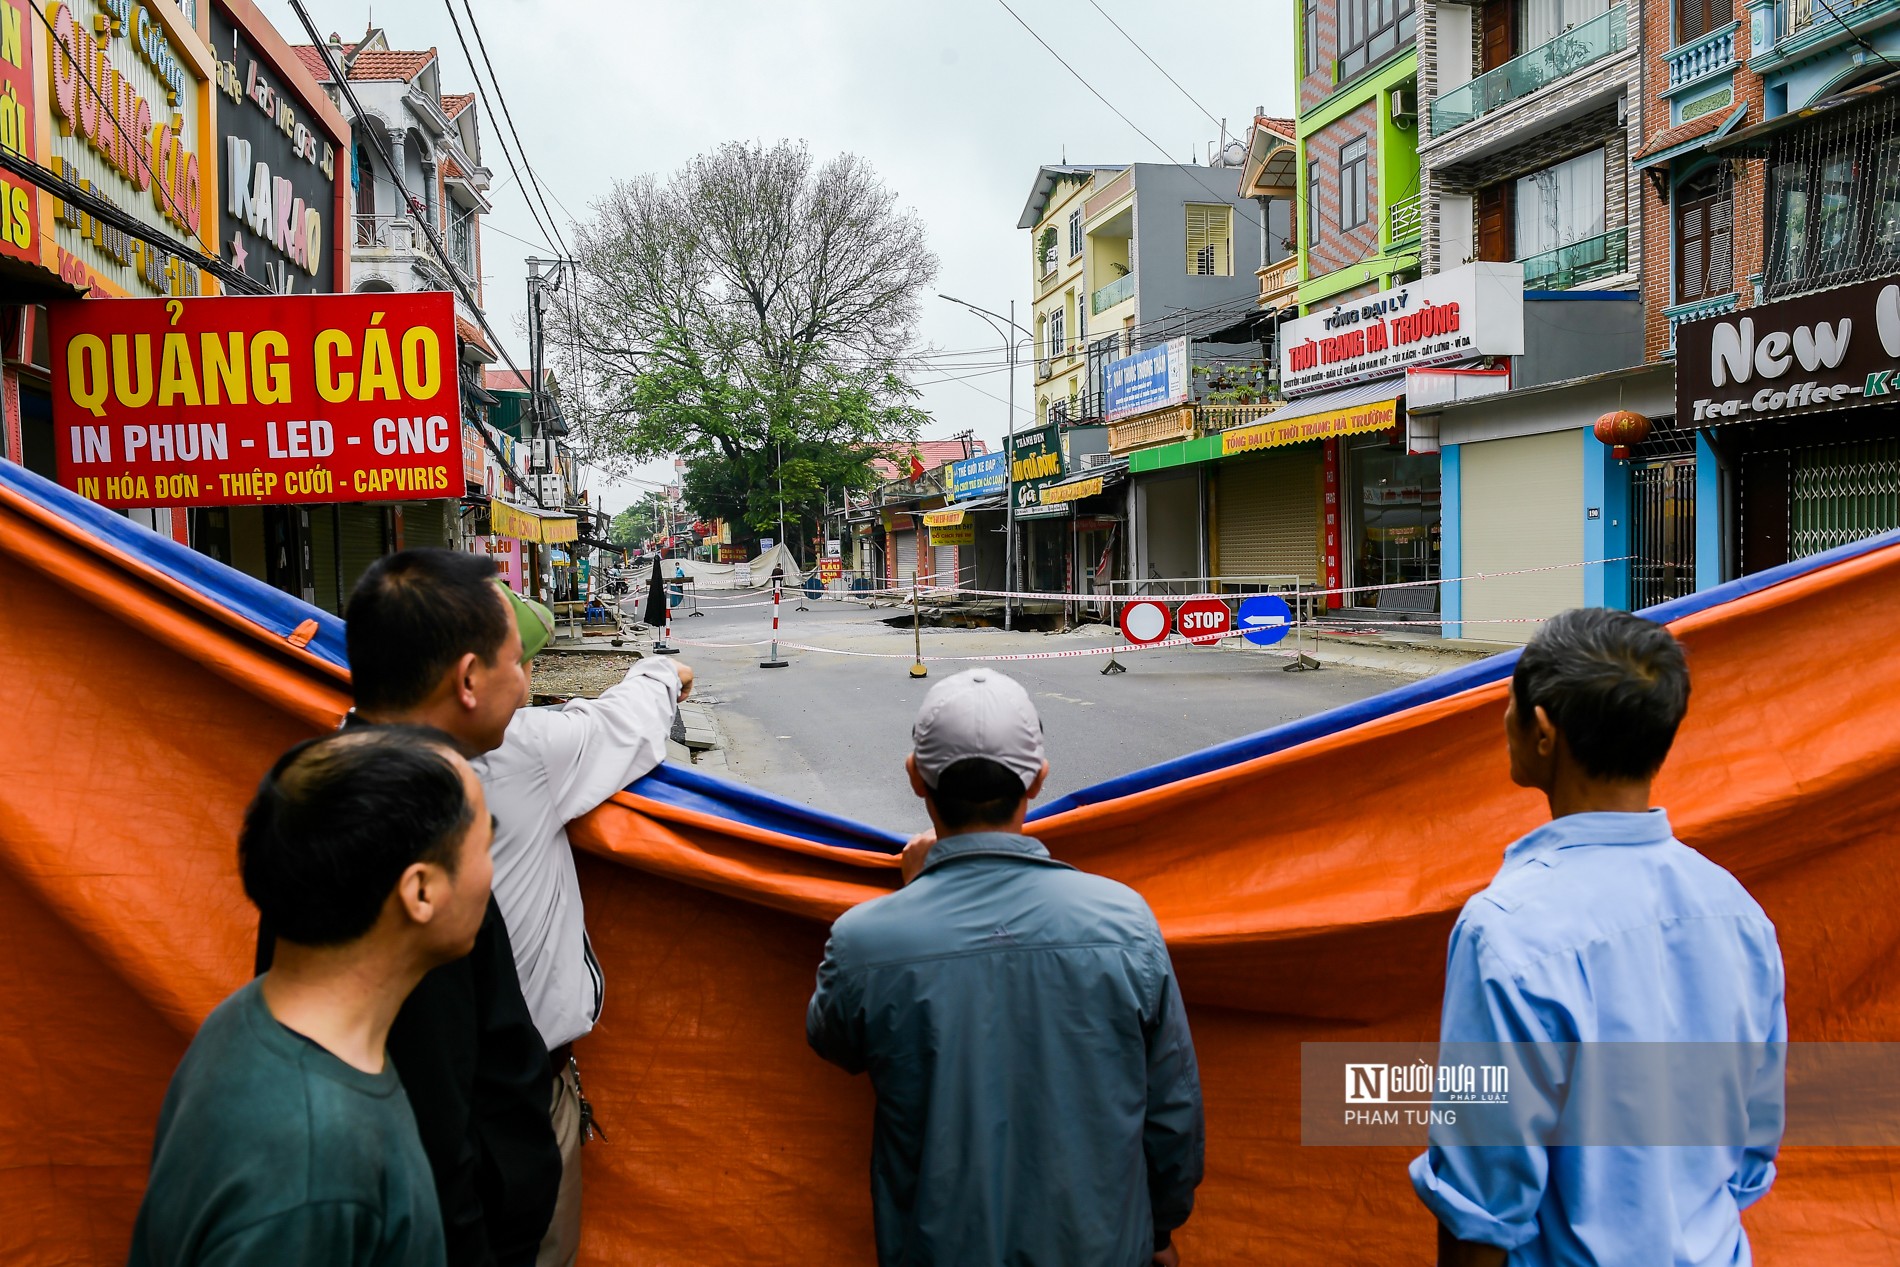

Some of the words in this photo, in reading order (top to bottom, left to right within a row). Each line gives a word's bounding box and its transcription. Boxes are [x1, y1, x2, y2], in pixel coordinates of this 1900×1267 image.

[46, 2, 152, 193] QUẢNG
[152, 112, 200, 236] CÁO
[227, 135, 321, 277] KAKAO
[1323, 306, 1360, 330] TỔNG
[1361, 300, 1388, 319] ĐẠI
[1389, 289, 1408, 311] LÝ
[67, 299, 292, 417] QUẢNG
[313, 311, 441, 404] CÁO
[1289, 337, 1318, 372] THỜI
[1319, 329, 1364, 365] TRANG
[1366, 317, 1388, 353] HÀ
[1391, 299, 1460, 347] TRƯỜNG
[1401, 349, 1417, 361] XÁCH
[1711, 316, 1852, 388] New
[70, 425, 112, 464] IN
[123, 422, 229, 463] PHUN
[266, 419, 335, 459] LED
[373, 414, 450, 456] CNC
[1248, 434, 1263, 447] ĐẠI
[1264, 428, 1276, 445] LÝ
[1278, 427, 1298, 441] THỜI
[1300, 420, 1331, 437] TRANG
[1333, 414, 1347, 431] HÀ
[1350, 408, 1393, 428] TRƯỜNG
[77, 476, 100, 500] IN
[106, 471, 150, 500] HÓA
[154, 473, 199, 499] ĐƠN
[218, 467, 278, 501] THIỆP
[284, 464, 334, 496] CƯỚI
[353, 465, 448, 494] CAPVIRIS
[1018, 481, 1036, 507] Gà
[1183, 611, 1225, 630] STOP
